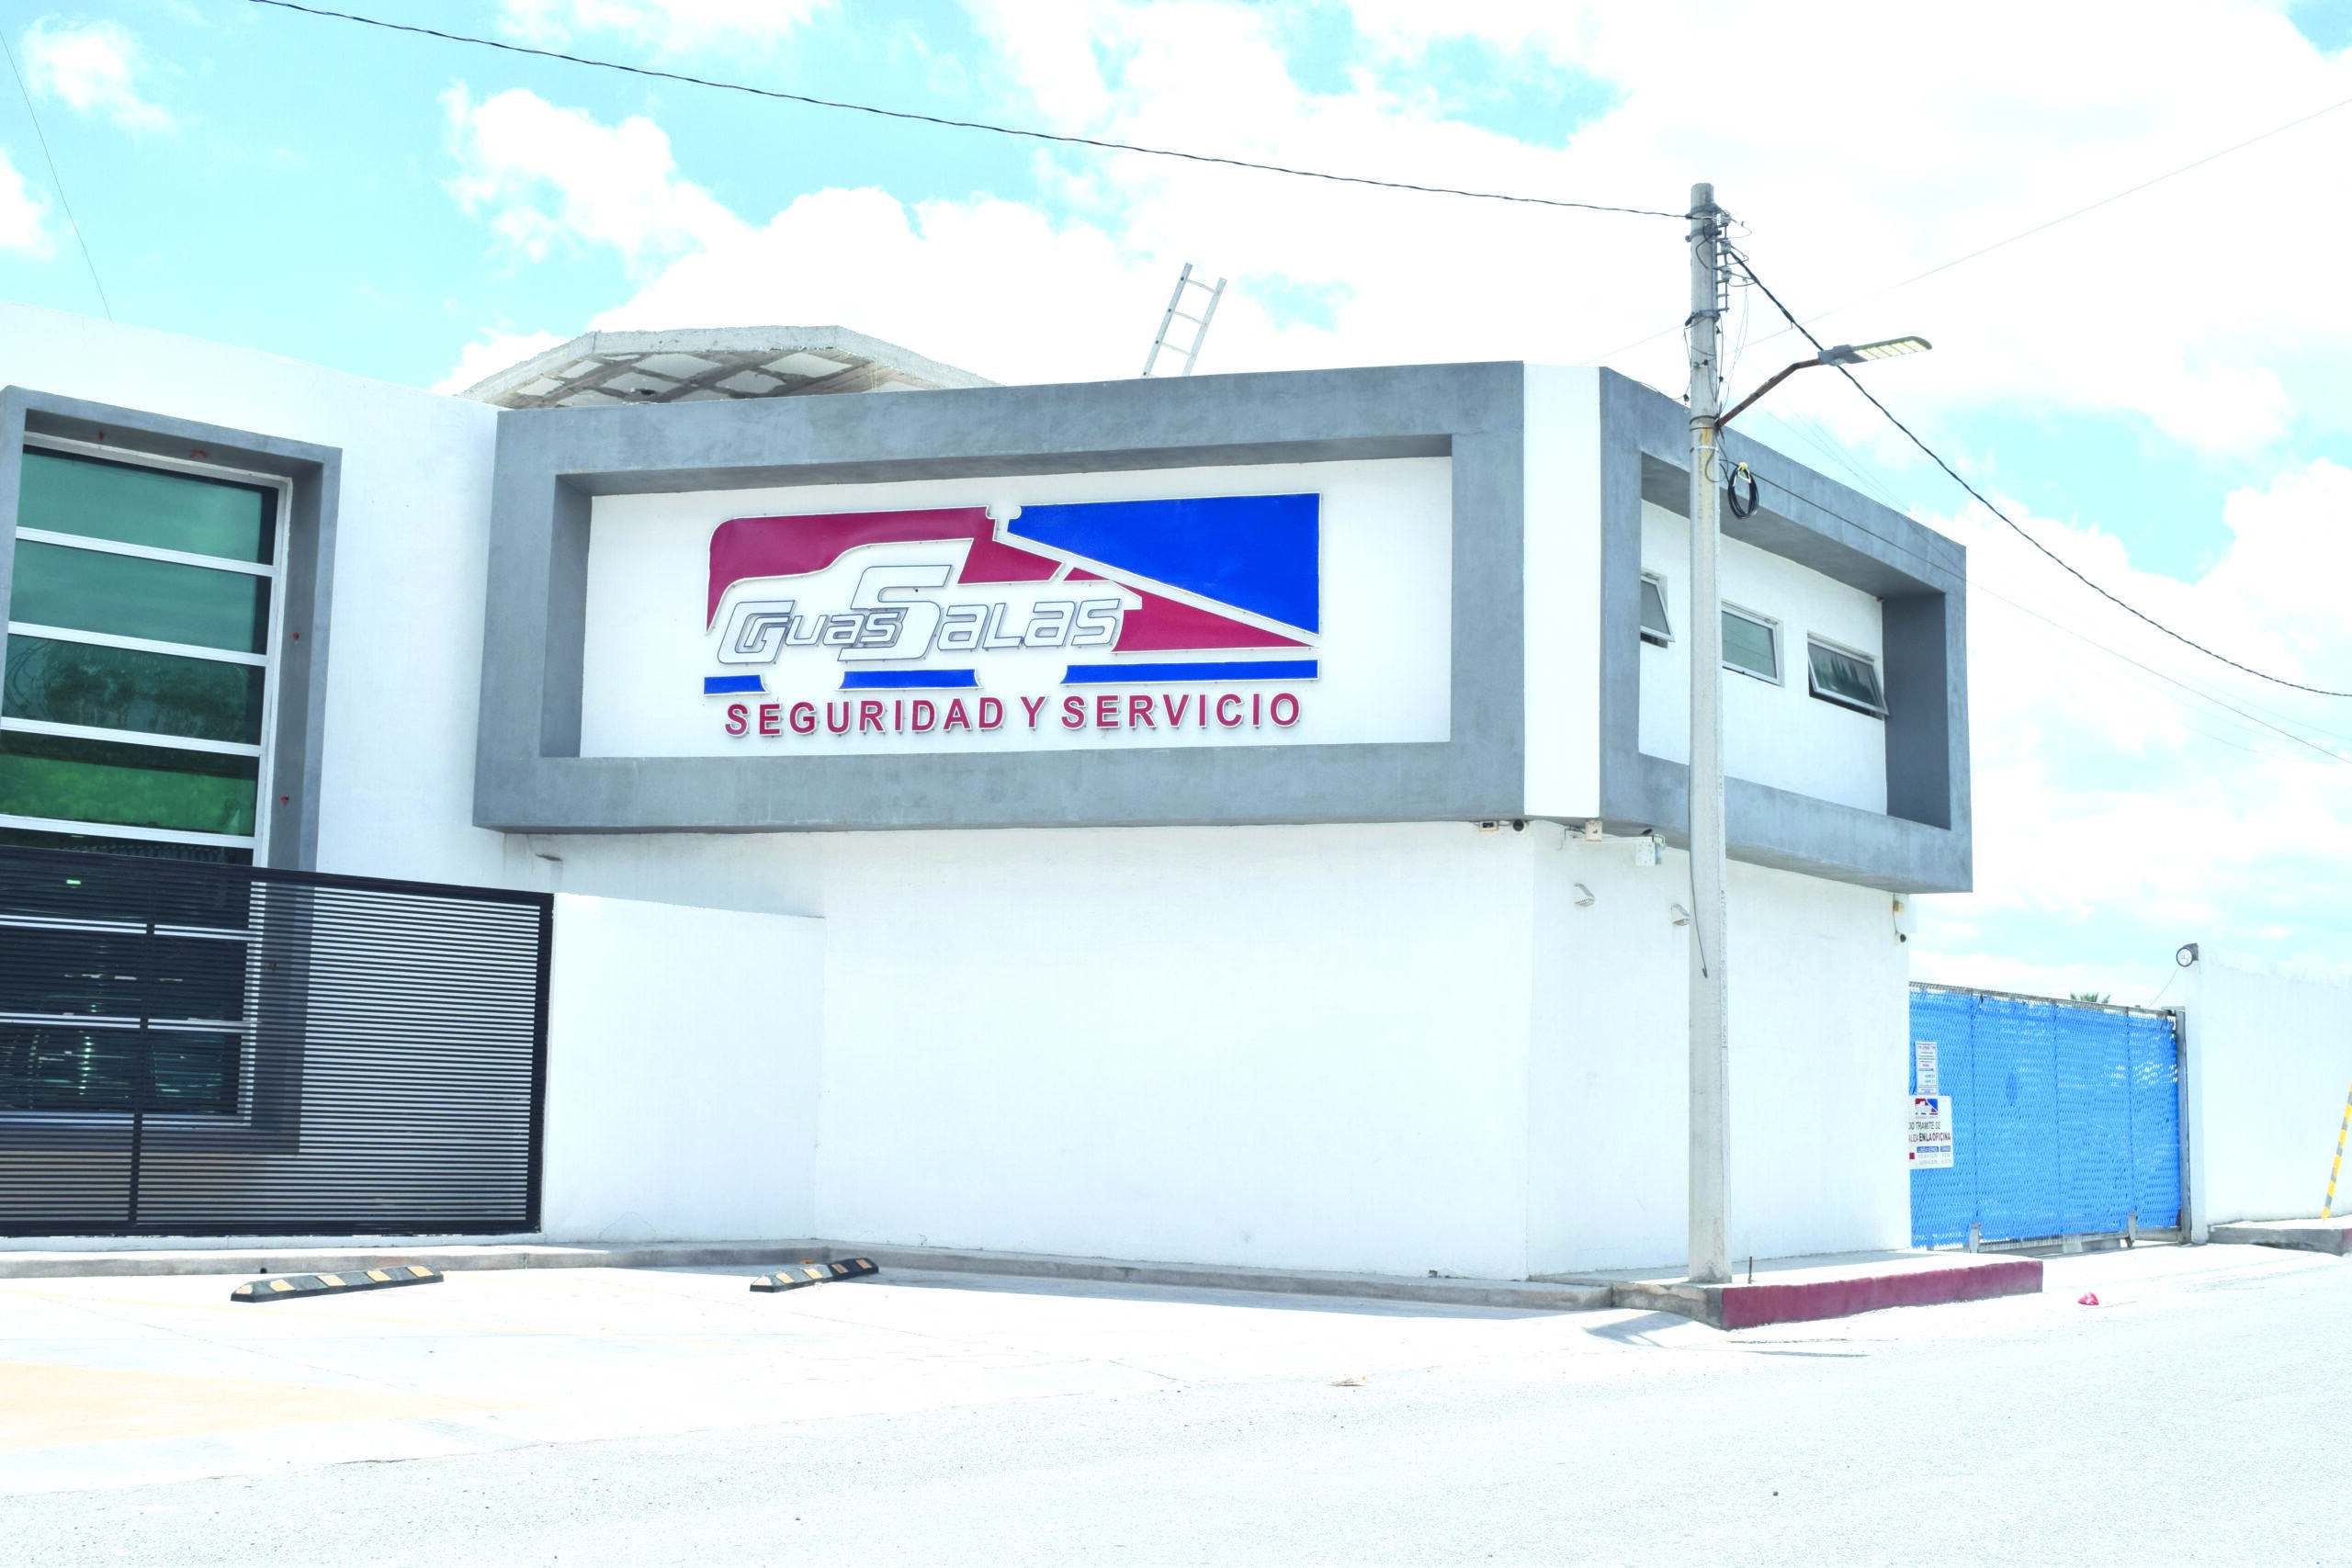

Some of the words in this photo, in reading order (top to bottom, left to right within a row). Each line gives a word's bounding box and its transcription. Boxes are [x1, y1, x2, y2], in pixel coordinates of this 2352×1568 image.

[724, 696, 1005, 736] SEGURIDAD
[1020, 695, 1046, 728] Y
[1061, 692, 1301, 729] SERVICIO
